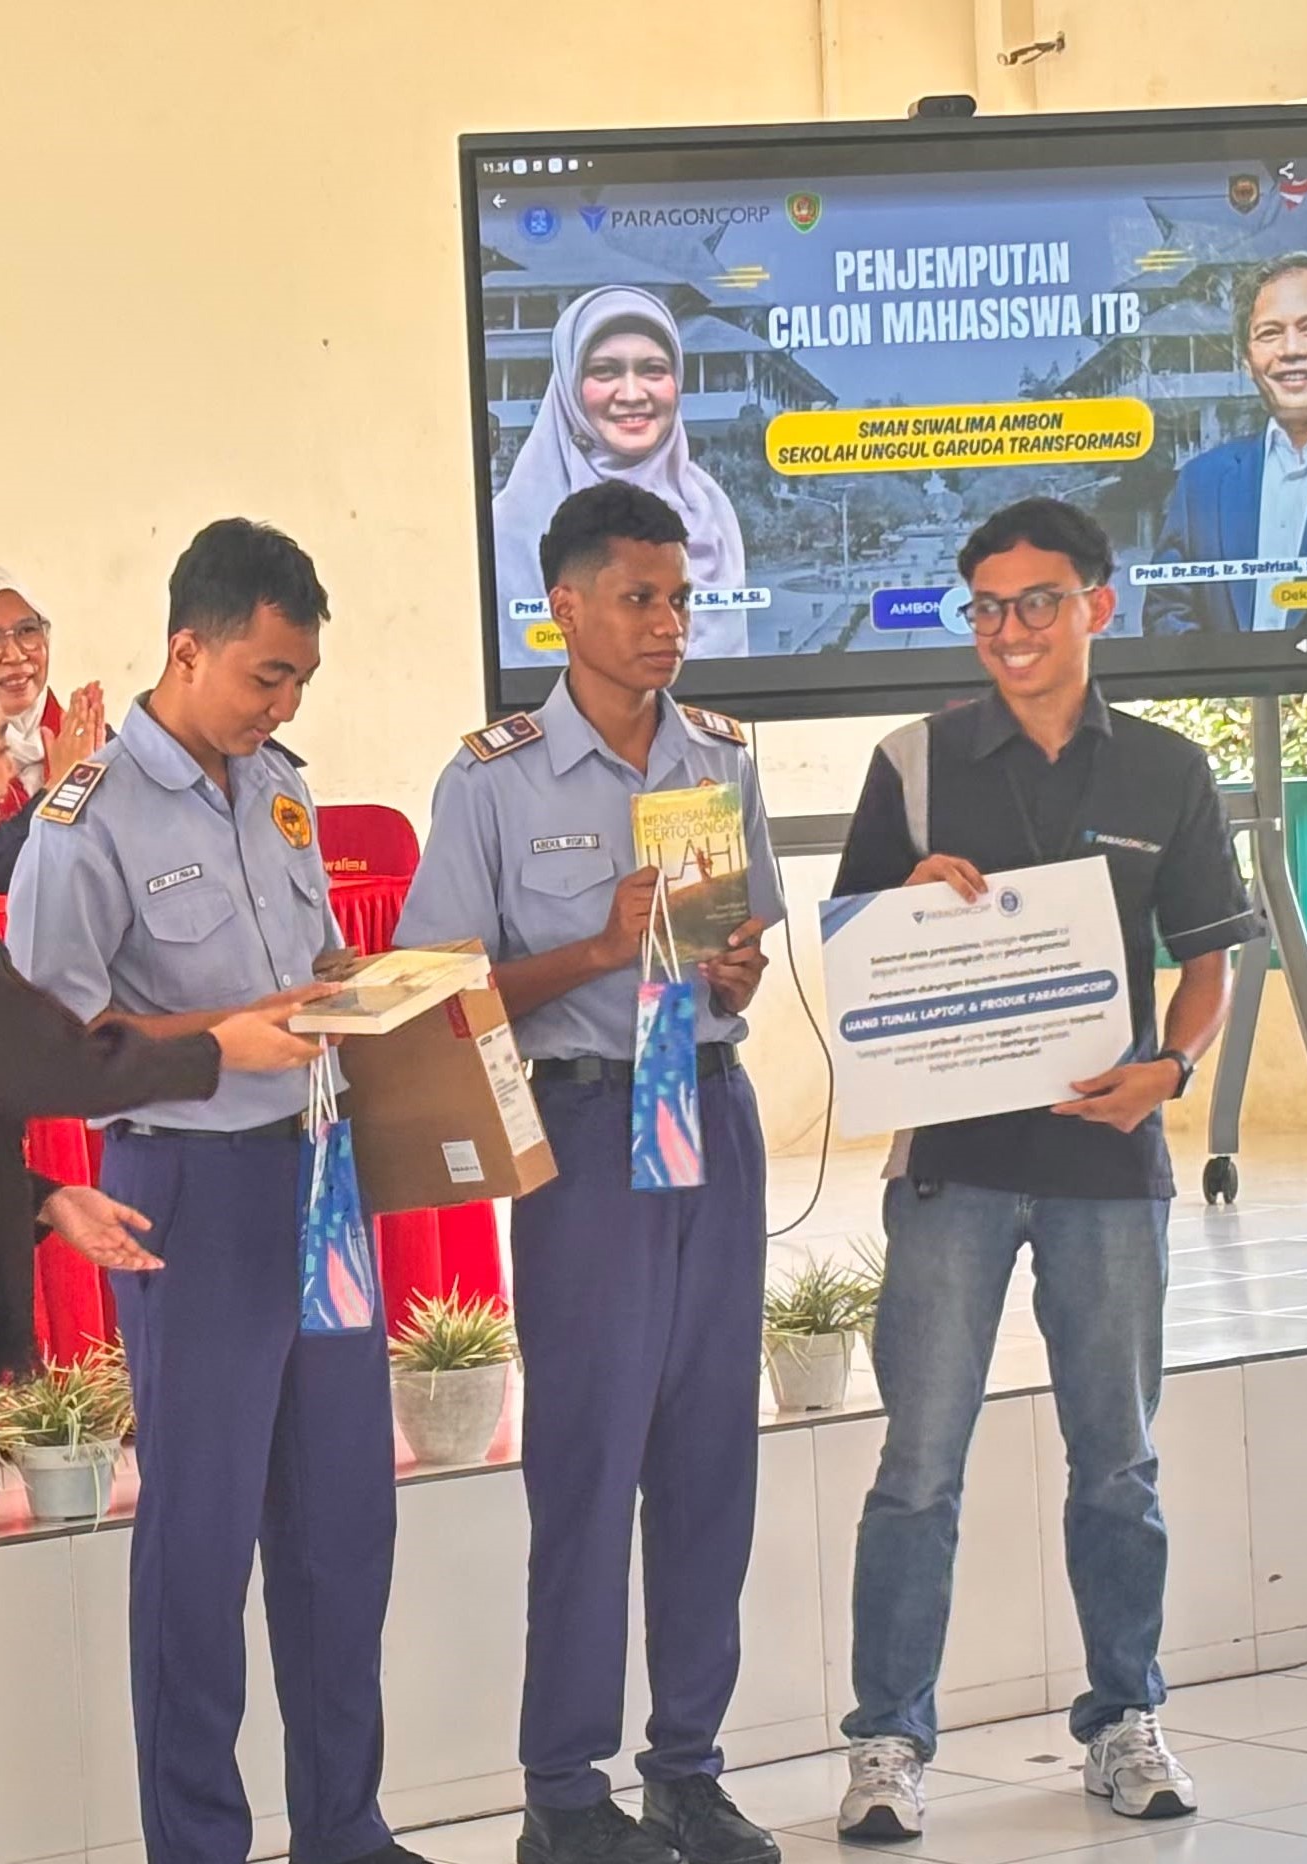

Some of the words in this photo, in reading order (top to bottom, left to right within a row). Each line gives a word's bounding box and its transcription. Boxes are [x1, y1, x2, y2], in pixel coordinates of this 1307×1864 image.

[611, 206, 770, 228] PARAGONCORP
[835, 242, 1070, 292] PENJEMPUTAN
[768, 303, 872, 350] CALON
[882, 294, 1082, 346] MAHASISWA
[1091, 292, 1141, 335] ITB
[858, 419, 908, 438] SMAN
[911, 416, 995, 436] SIWALIMA
[999, 412, 1064, 432] AMBON
[778, 444, 859, 465] SEKOLAH
[861, 440, 930, 460] UNGGUL
[932, 437, 1005, 457] GARUDA
[1008, 430, 1143, 454] TRANSFORMASI
[515, 601, 548, 614] Prof.
[643, 805, 740, 827] MENGUSAHAKAN
[644, 819, 741, 842] PERTOLONGAN
[845, 1017, 879, 1032] UANG
[920, 1003, 967, 1020] LAPTOP,
[968, 1001, 978, 1012] &
[980, 994, 1026, 1011] PRODUK
[1028, 980, 1111, 1003] PARAGONCORP
